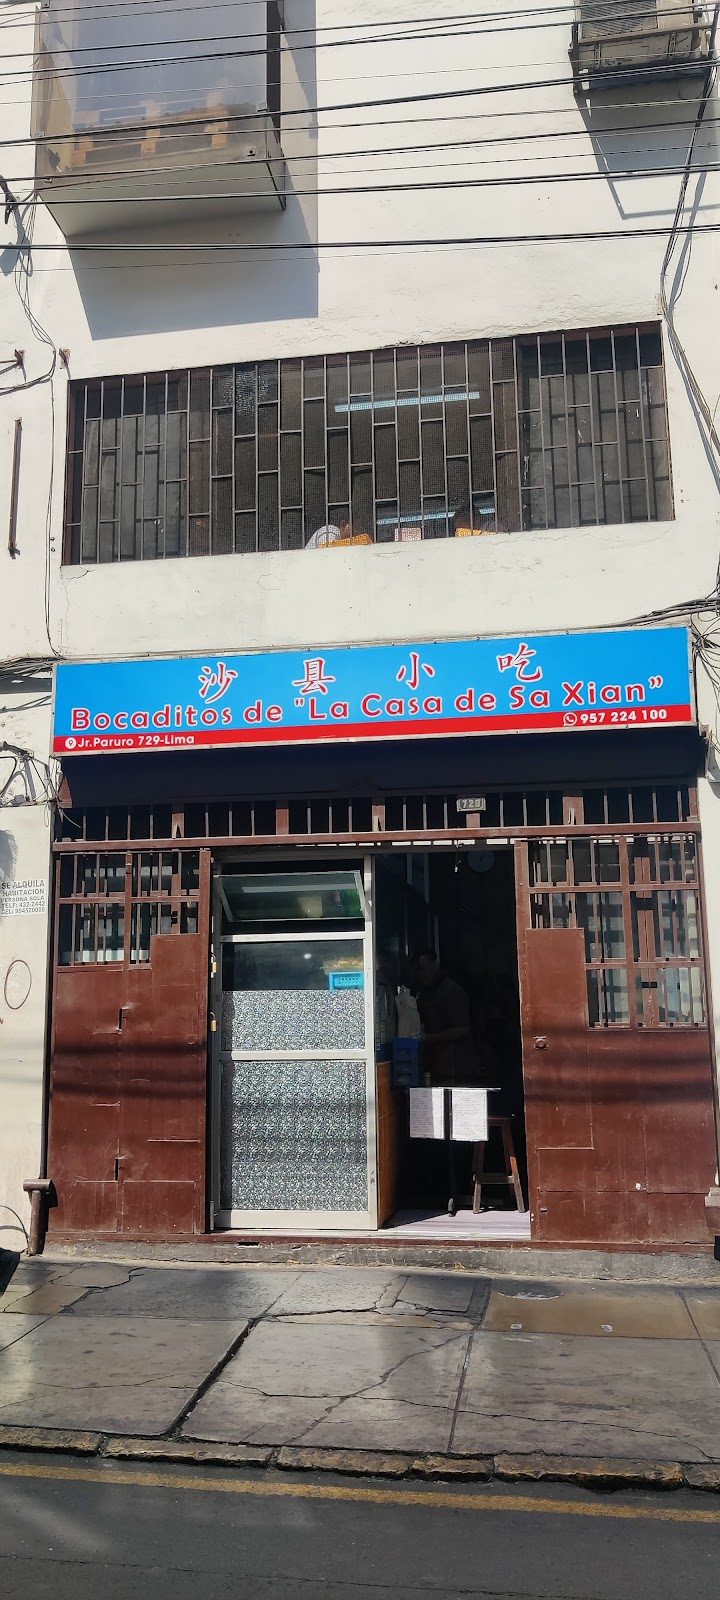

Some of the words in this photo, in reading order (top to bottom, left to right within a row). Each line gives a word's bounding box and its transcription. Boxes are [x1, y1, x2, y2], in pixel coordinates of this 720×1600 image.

[198, 642, 543, 704] 沙县小吃
[71, 704, 233, 730] Bocaditos
[243, 700, 283, 723] de
[361, 693, 443, 718] Casa
[454, 688, 496, 713] de
[508, 685, 550, 709] Sa
[580, 712, 605, 724] 957
[611, 710, 637, 723] 224
[641, 708, 667, 721] 100
[77, 736, 134, 749] Jr.Paruro
[138, 734, 195, 747] 729-Lima
[13, 880, 44, 888] ALQUILA
